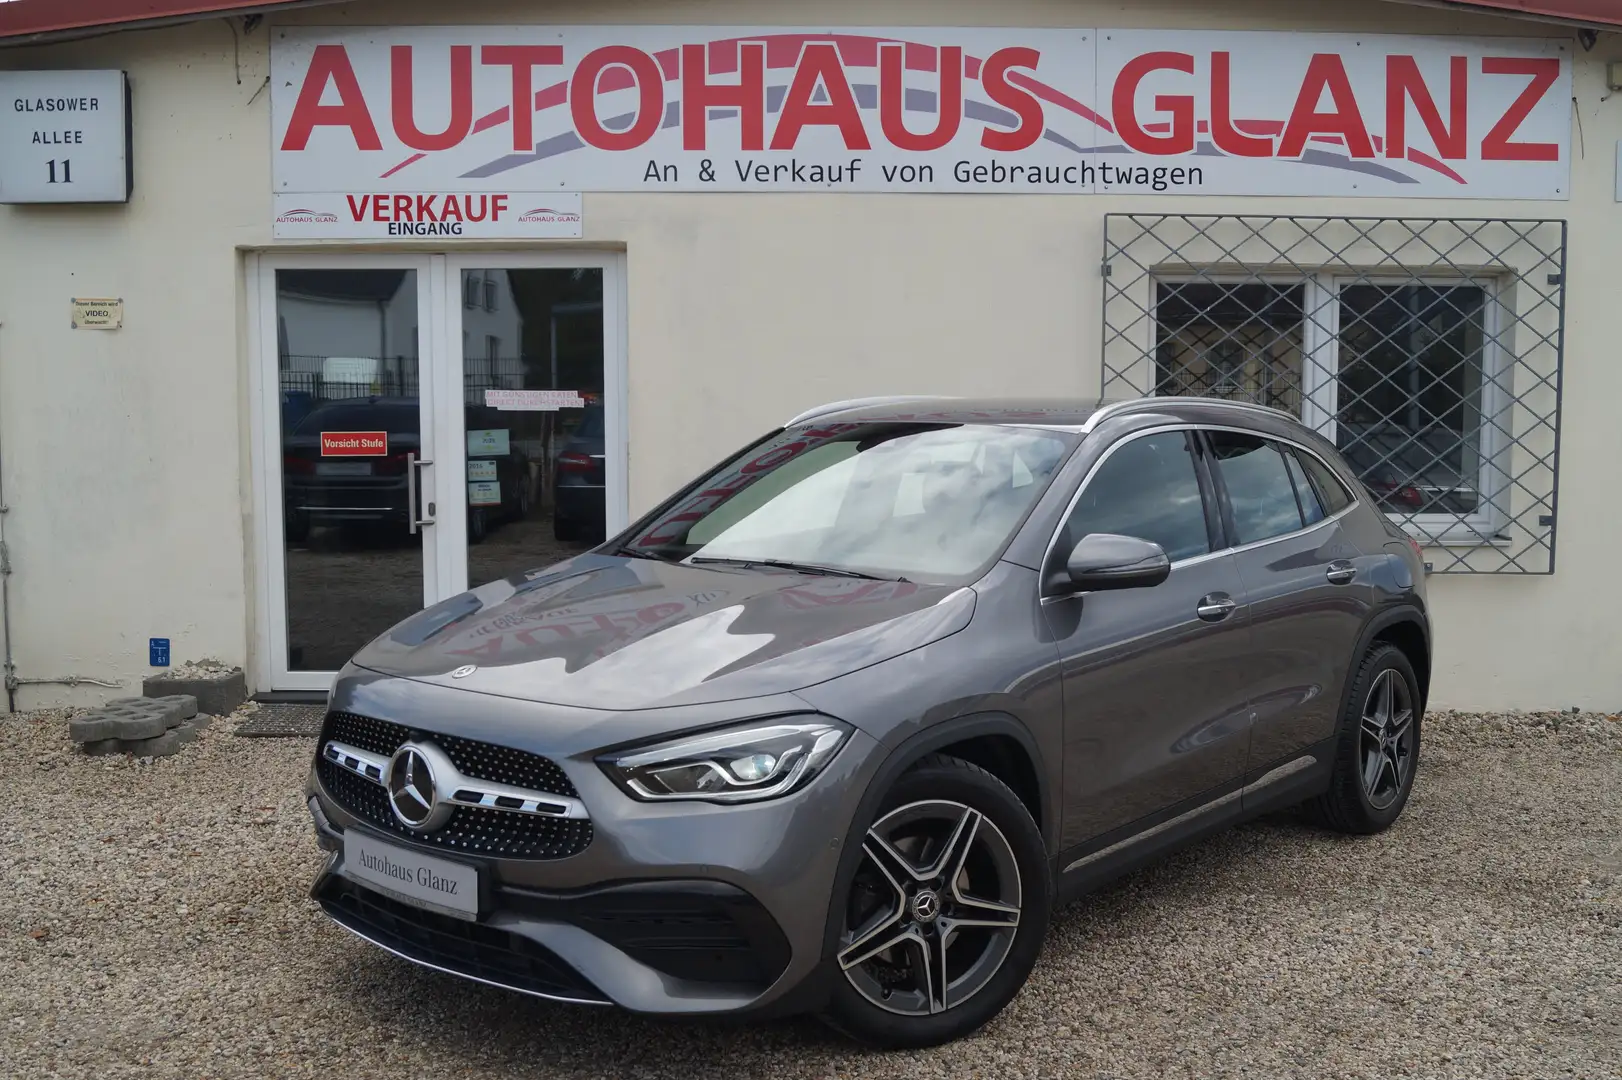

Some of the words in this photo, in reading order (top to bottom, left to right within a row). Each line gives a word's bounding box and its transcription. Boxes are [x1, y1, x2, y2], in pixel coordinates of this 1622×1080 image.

[14, 98, 99, 112] GLASOWER
[280, 45, 1043, 153] AUTOHAUS
[1112, 51, 1560, 162] GLANZ
[32, 130, 83, 144] ALLEE
[45, 158, 73, 184] 11
[643, 160, 679, 182] An
[698, 159, 717, 182] &
[734, 158, 862, 183] Verkauf
[881, 165, 933, 183] von
[953, 159, 1204, 191] Gebrauchtwagen
[346, 195, 508, 222] VERKAUF
[388, 222, 463, 235] EINGANG
[324, 438, 359, 448] Vorsicht
[361, 438, 384, 448] Stufe
[358, 848, 413, 883] Autohaus
[416, 866, 458, 895] Glanz
